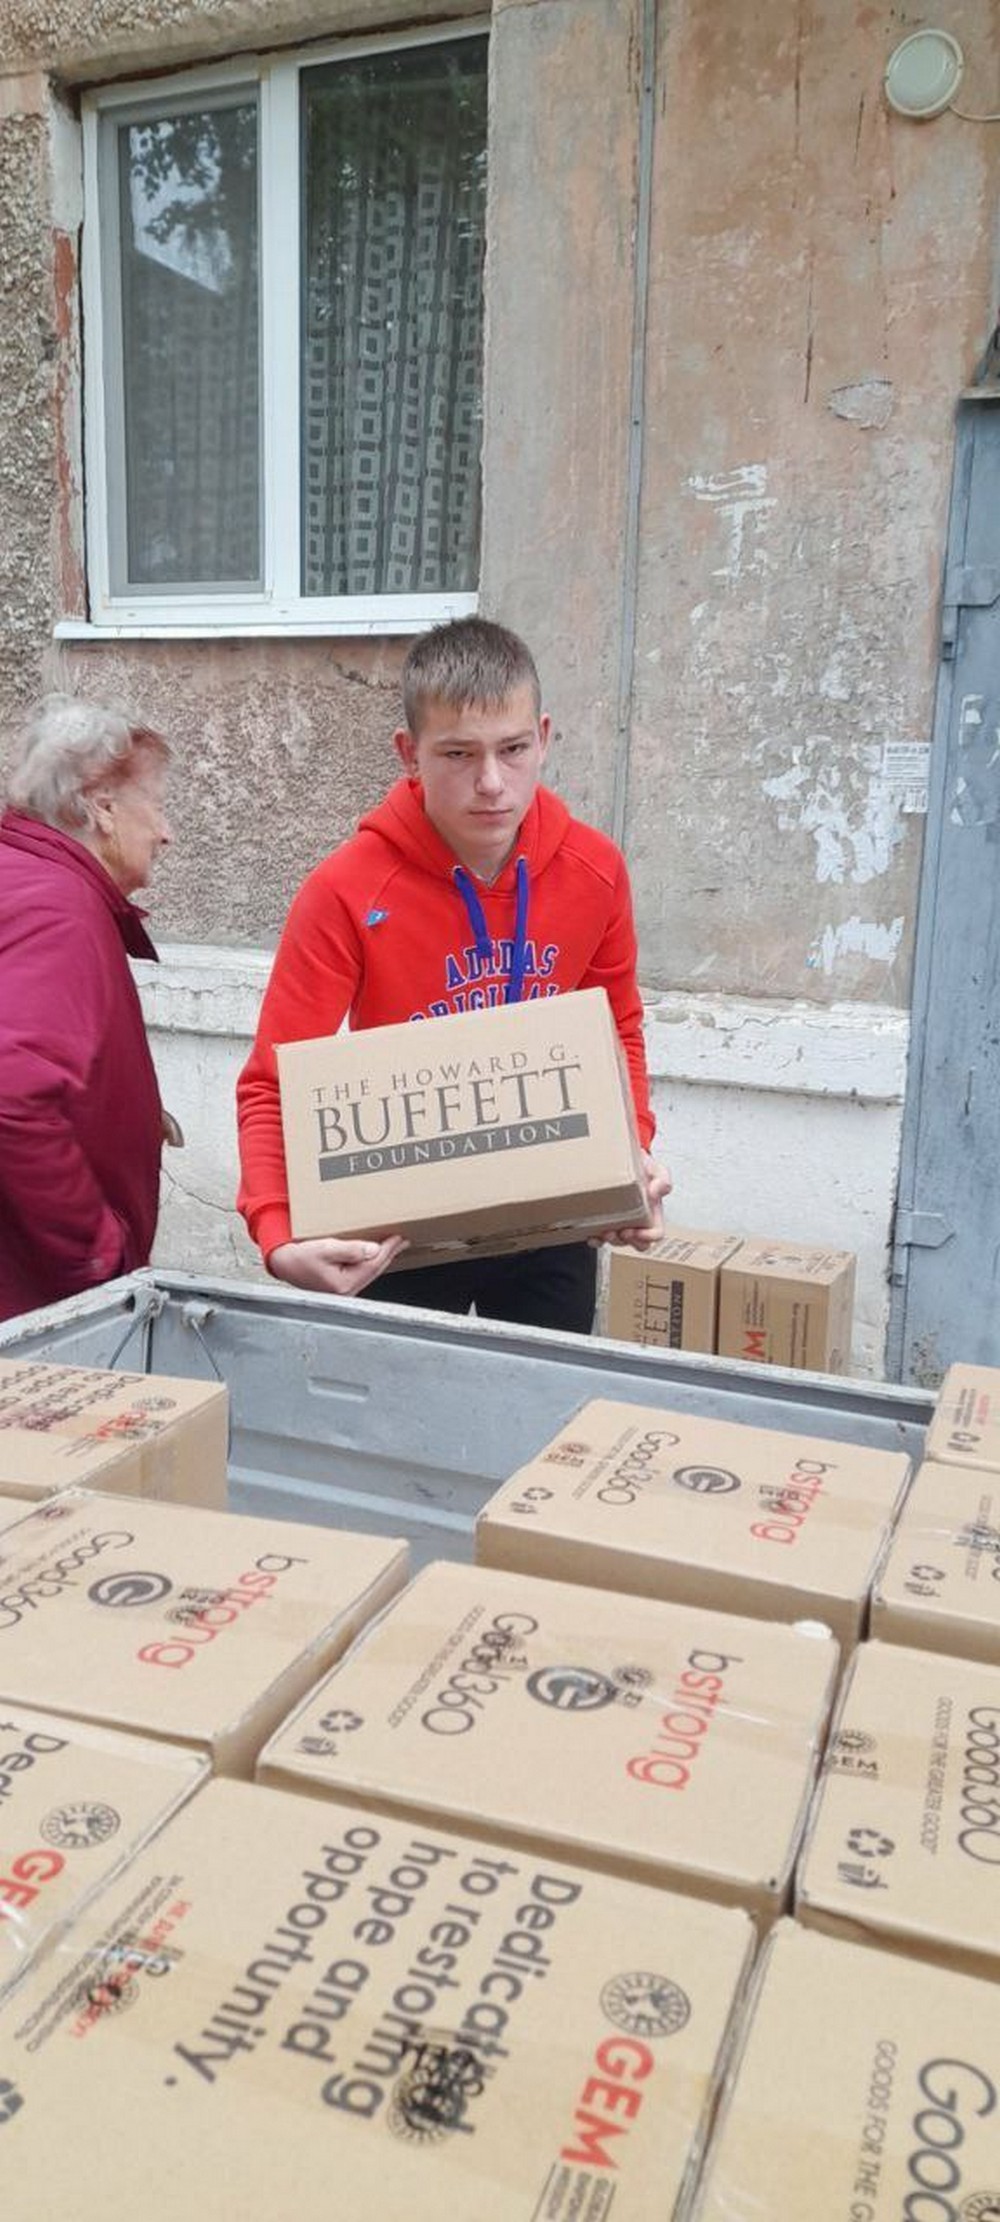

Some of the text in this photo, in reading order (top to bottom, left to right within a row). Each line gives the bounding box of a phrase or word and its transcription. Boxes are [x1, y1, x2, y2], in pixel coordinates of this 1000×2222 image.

[446, 939, 559, 991] ADIDAS
[312, 1044, 580, 1102] THE HOWARD G.
[314, 1064, 582, 1153] BUFFETT
[347, 1121, 563, 1173] FOUNDATION
[626, 1648, 744, 1791] bstrong
[353, 1840, 458, 1946] hope
[459, 1857, 520, 1897] to
[280, 1958, 370, 2064] and
[321, 1903, 481, 2121] restoring
[560, 2036, 655, 2170] GEM
[867, 2039, 898, 2112] GOODS
[854, 2158, 881, 2198] THE
